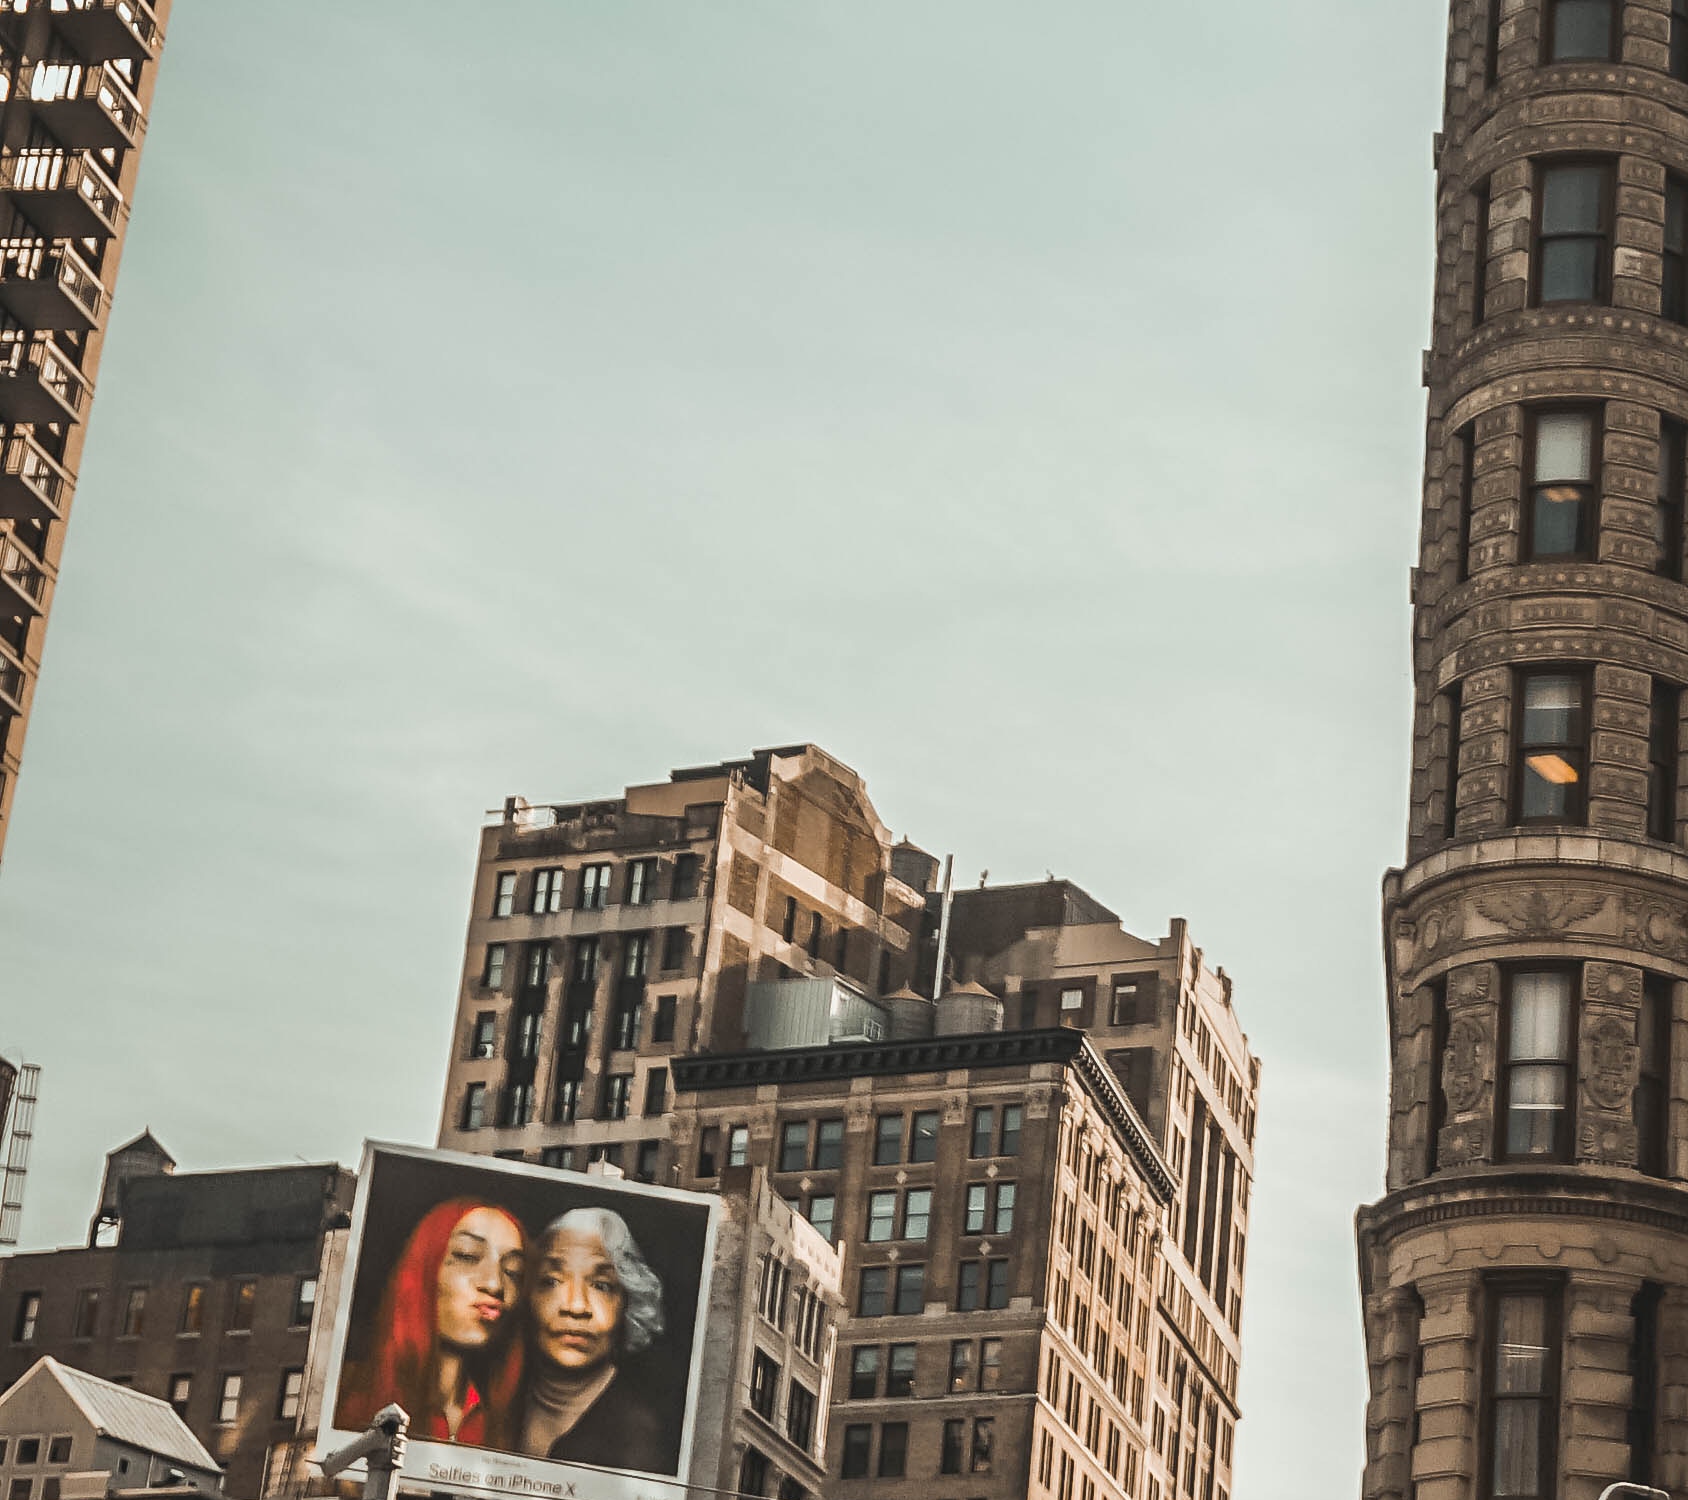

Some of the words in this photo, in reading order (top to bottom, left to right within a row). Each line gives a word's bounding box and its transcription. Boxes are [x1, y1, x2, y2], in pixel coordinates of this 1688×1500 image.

[429, 1463, 480, 1483] Selfies
[484, 1473, 504, 1487] on
[508, 1474, 561, 1496] iPhone
[565, 1482, 577, 1497] X
